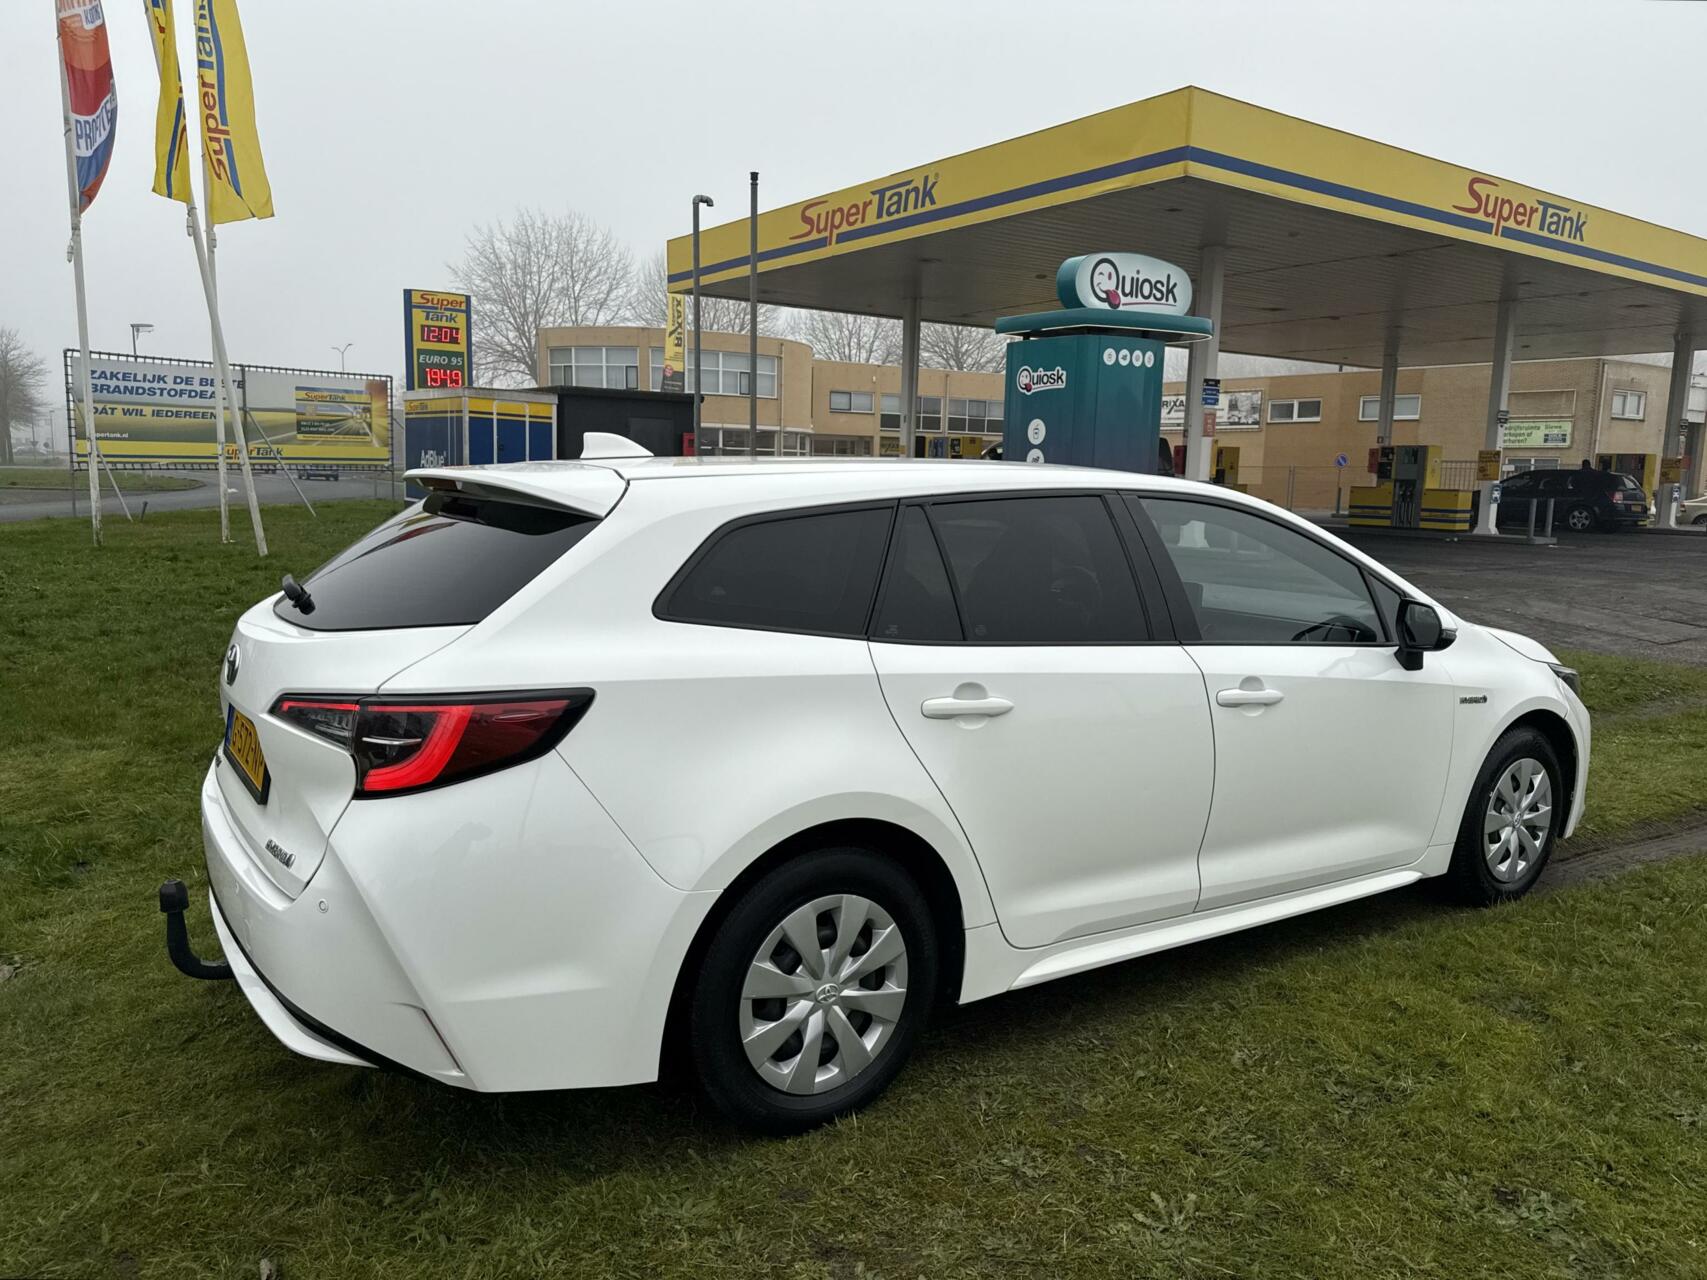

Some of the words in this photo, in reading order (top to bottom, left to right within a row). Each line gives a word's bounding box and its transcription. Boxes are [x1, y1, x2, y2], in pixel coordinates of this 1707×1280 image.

[1452, 177, 1587, 242] SuperTank
[1090, 258, 1178, 309] Quiosk
[412, 293, 465, 312] Super
[421, 310, 459, 324] Tank
[423, 327, 462, 343] 12:04
[419, 354, 448, 365] EURO
[451, 357, 463, 366] 95
[90, 369, 168, 385] ZAKELIJK
[173, 375, 195, 386] DE
[1018, 368, 1064, 393] Quiosk
[91, 383, 226, 401] BRANDSTOFDEA
[122, 407, 147, 417] WIL
